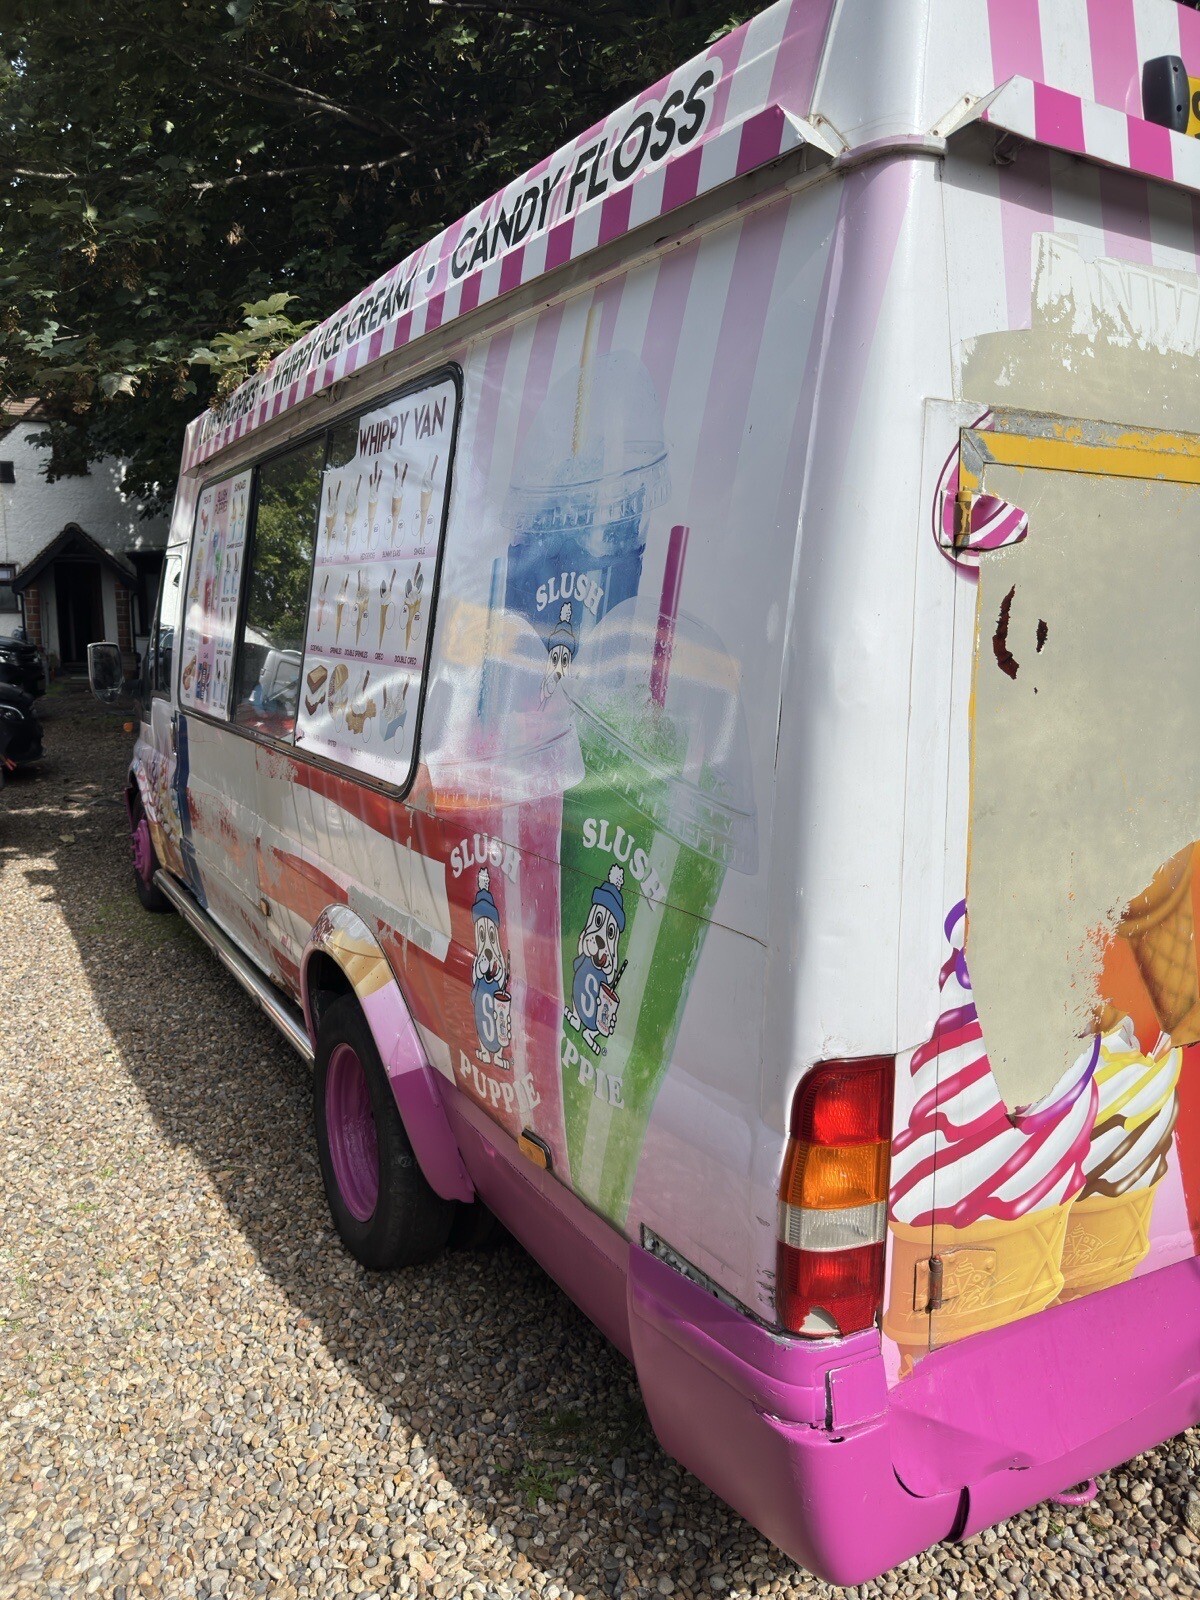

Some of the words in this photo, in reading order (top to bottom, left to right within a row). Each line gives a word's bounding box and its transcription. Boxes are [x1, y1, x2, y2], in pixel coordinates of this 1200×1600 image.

[273, 331, 323, 393] WHIPPY
[319, 314, 349, 364] ICE
[346, 262, 419, 344] CREAM
[452, 165, 567, 279] CANDY
[565, 69, 715, 215] FLOSS
[360, 410, 410, 458] WHIPPY
[414, 396, 447, 441] VAN
[536, 571, 604, 616] SLUSH
[449, 832, 523, 884] SLUSH
[582, 818, 668, 912] SLUSH
[482, 993, 495, 1043] S
[580, 973, 598, 1018] S
[459, 1049, 541, 1114] PUPPIE
[558, 1033, 625, 1110] PPIE
